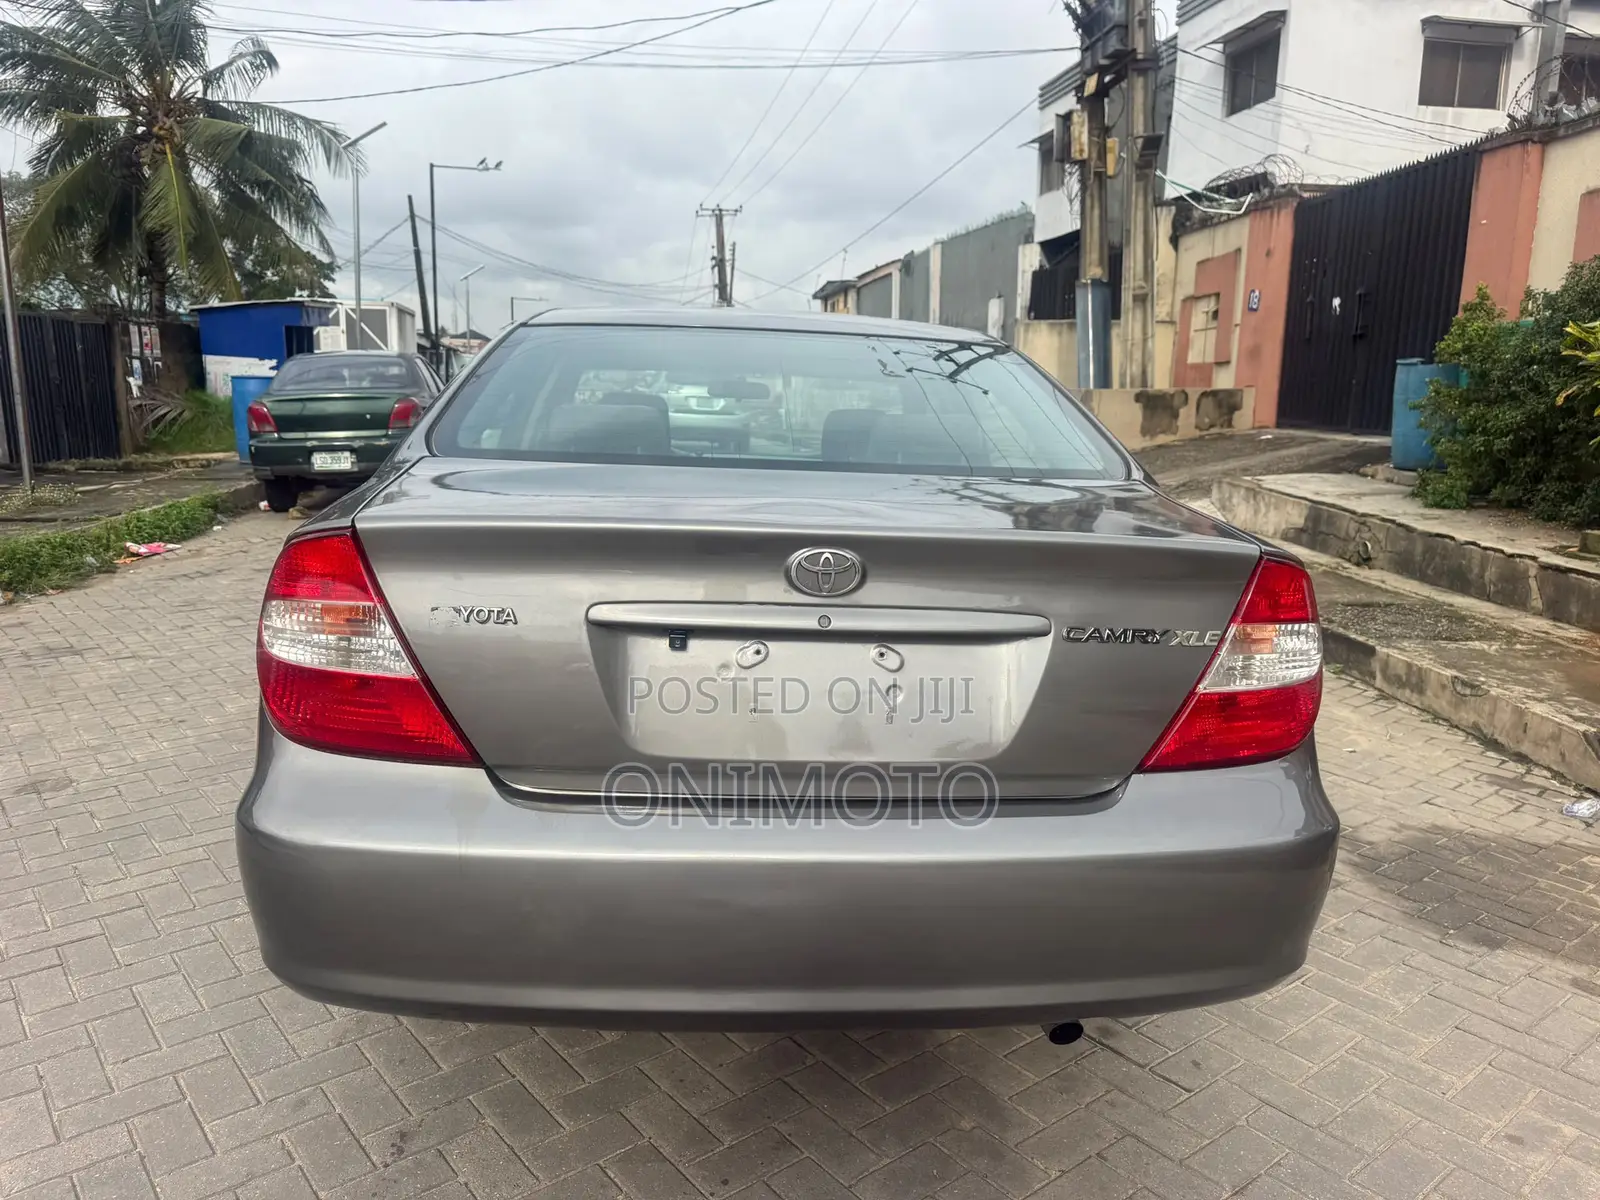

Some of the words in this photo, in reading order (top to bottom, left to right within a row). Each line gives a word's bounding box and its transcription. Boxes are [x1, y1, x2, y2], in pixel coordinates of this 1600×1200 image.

[1249, 290, 1259, 309] 18
[431, 606, 518, 624] YOTA
[1062, 627, 1170, 644] CAMRY
[1169, 630, 1223, 647] XLE
